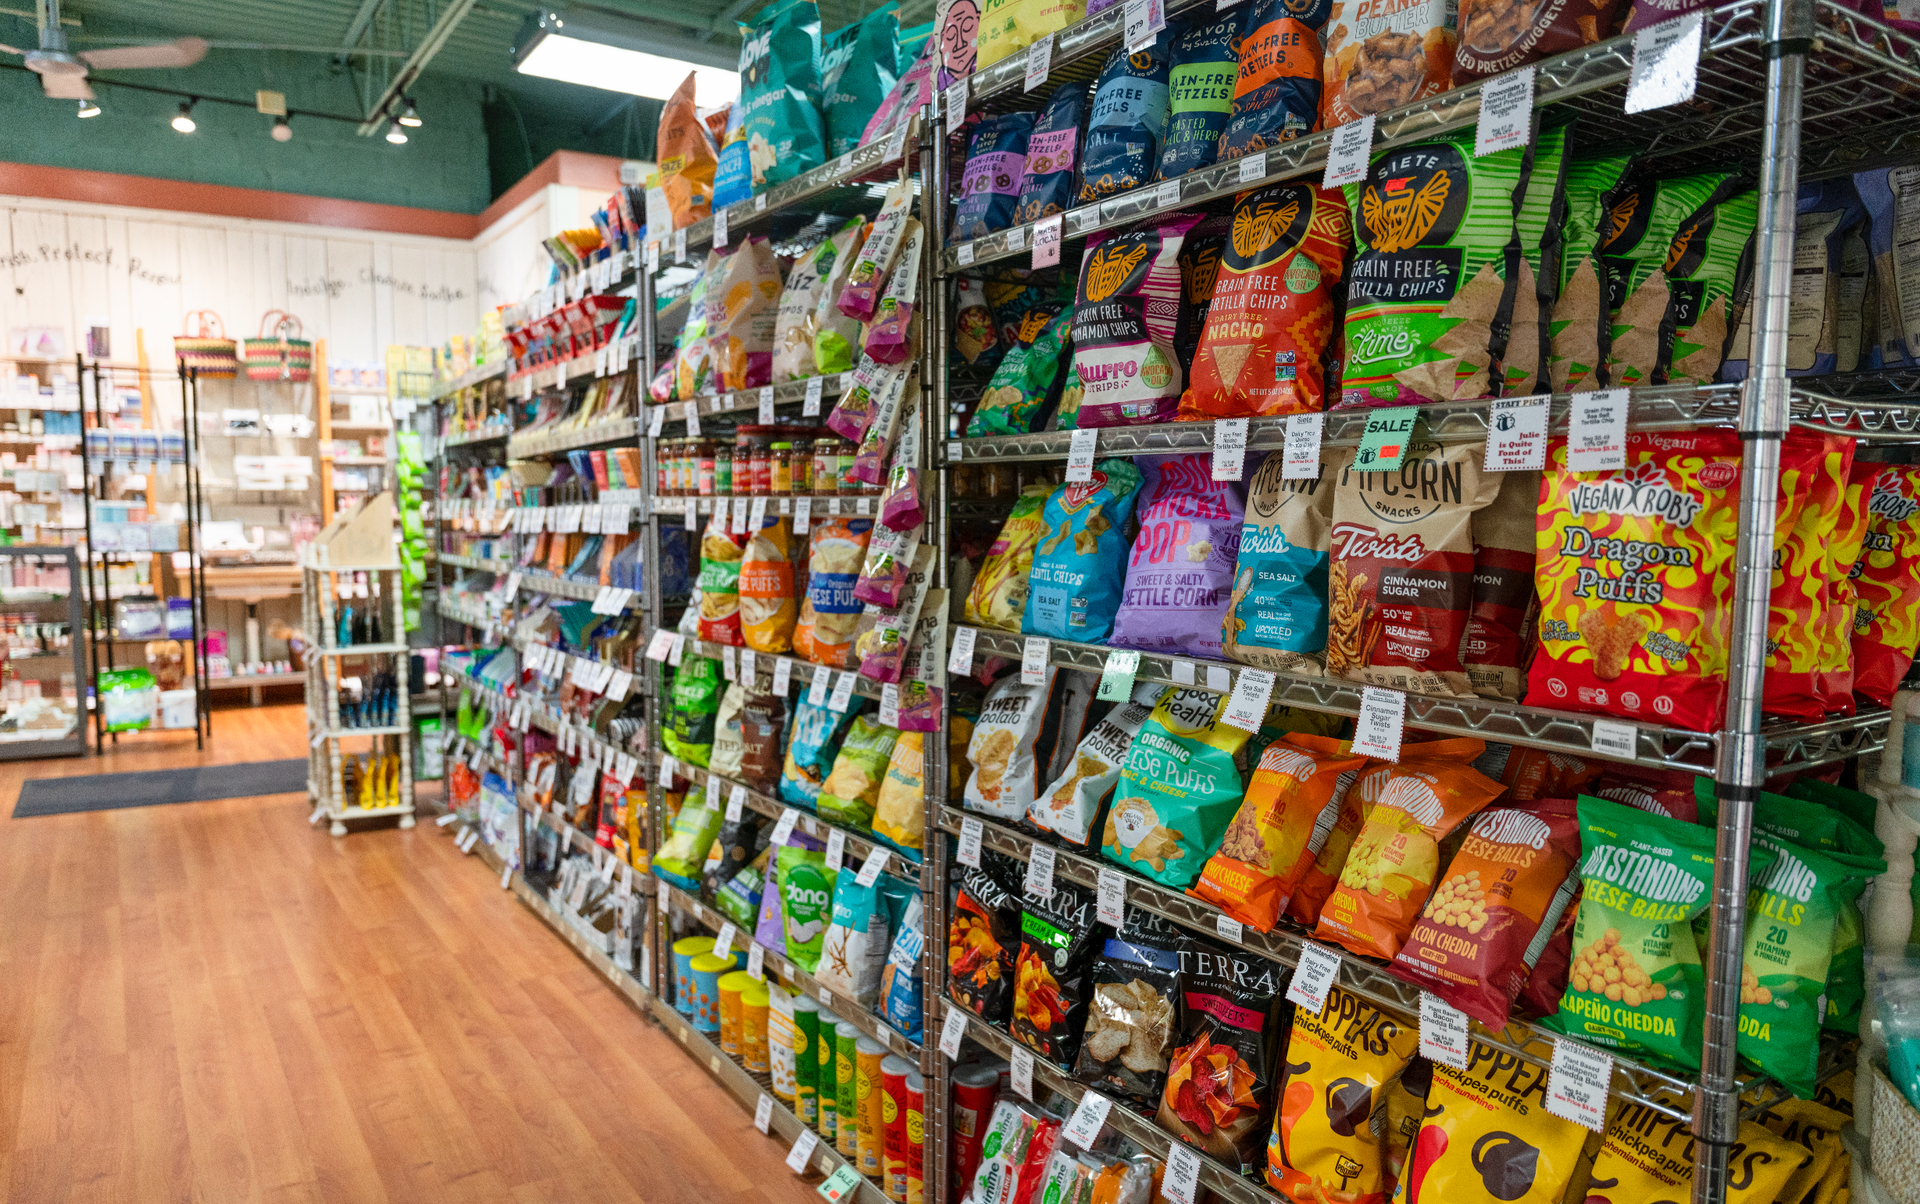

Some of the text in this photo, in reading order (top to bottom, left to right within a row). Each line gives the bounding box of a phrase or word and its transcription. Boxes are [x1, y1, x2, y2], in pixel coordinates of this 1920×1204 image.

[1355, 2, 1430, 38] BUTTER
[1184, 22, 1237, 41] SAVOR
[1182, 38, 1219, 51] by Suzie
[1477, 50, 1526, 74] PRETZEL
[1484, 88, 1528, 106] Peanut Butter
[1193, 130, 1219, 141] HERB
[1377, 154, 1439, 179] SIETE
[1253, 188, 1297, 202] SIETE
[1035, 234, 1059, 246] LOCAL
[1395, 260, 1432, 278] FREE
[1216, 275, 1279, 294] GRAIN FREE
[1400, 279, 1445, 297] CHIPS
[1250, 294, 1288, 310] CHIPS
[1101, 304, 1123, 320] FREE
[1215, 313, 1262, 323] DAIRY FREE
[1109, 321, 1138, 337] CHIPS
[1208, 322, 1264, 341] NACHO
[1351, 330, 1415, 365] Lime
[1495, 397, 1545, 409] STAFF PICK
[1367, 420, 1412, 434] SALE
[1508, 440, 1533, 449] Quite
[1518, 431, 1540, 441] Julie
[1645, 433, 1698, 450] Vegan!
[1522, 448, 1532, 456] of
[1502, 457, 1525, 465] This!
[1375, 502, 1421, 518] SNACKS
[1570, 484, 1702, 528] VEGAN ROB'S
[1131, 520, 1191, 567] POP
[1241, 527, 1290, 553] Twists
[1333, 526, 1424, 562] Twists
[1560, 526, 1693, 571] Dragon
[1053, 569, 1084, 586] CHIPS
[1136, 574, 1205, 587] SWEET & SALTY
[1258, 572, 1296, 583] SEA SALT
[1383, 576, 1447, 590] CINNAMON
[1382, 586, 1419, 598] SUGAR
[1574, 568, 1663, 605] Puffs
[1048, 597, 1062, 606] SALT
[1173, 587, 1218, 606] CORN
[1257, 610, 1275, 620] REAL
[1255, 624, 1292, 637] UPCYCLED
[1385, 625, 1407, 638] REAL
[1386, 641, 1430, 658] UPCYCLED
[984, 696, 1032, 712] SWEET
[1365, 704, 1399, 716] Cinnamon
[976, 711, 1021, 728] potato
[1158, 698, 1216, 732] health
[1370, 719, 1391, 728] Twists
[1371, 712, 1391, 722] Sugar
[1140, 733, 1191, 763] ORGANIC
[1139, 776, 1189, 799] & CHEESE
[1165, 764, 1215, 796] PUFFS
[1389, 832, 1405, 848] 20
[1630, 839, 1673, 857] PLANT-BASED
[1496, 846, 1536, 868] BALLS
[1219, 867, 1254, 894] CHEESE
[1500, 867, 1517, 883] 20
[787, 881, 830, 911] dang
[1333, 887, 1356, 910] CHEDDA
[1631, 893, 1690, 922] BALLS
[1025, 919, 1045, 936] CREAM
[1652, 923, 1670, 939] 20
[1766, 925, 1789, 945] 20
[1437, 932, 1478, 961] CHEDDA
[1756, 941, 1792, 958] VITAMINS
[1304, 956, 1318, 969] Dairy
[1419, 960, 1429, 970] YOU
[1759, 951, 1789, 966] MINERALS
[1176, 950, 1276, 994] TERRA
[1422, 1014, 1465, 1034] Chedda Balls
[1433, 1012, 1454, 1024] Bacon
[1614, 1008, 1677, 1038] CHEDDA
[1294, 1014, 1358, 1060] chickpea puffs
[1590, 1035, 1618, 1047] YOU EAT
[1560, 1042, 1608, 1064] OUTSTANDING
[1562, 1062, 1598, 1080] Jalapeno
[1563, 1054, 1600, 1073] Plant Based
[1554, 1065, 1604, 1090] Chedda Balls
[1461, 1086, 1496, 1112] sunshine
[1488, 1087, 1530, 1117] puffs
[1554, 1093, 1566, 1101] Sale
[1608, 1126, 1669, 1167] chickpea
[1638, 1160, 1676, 1188] barbecue
